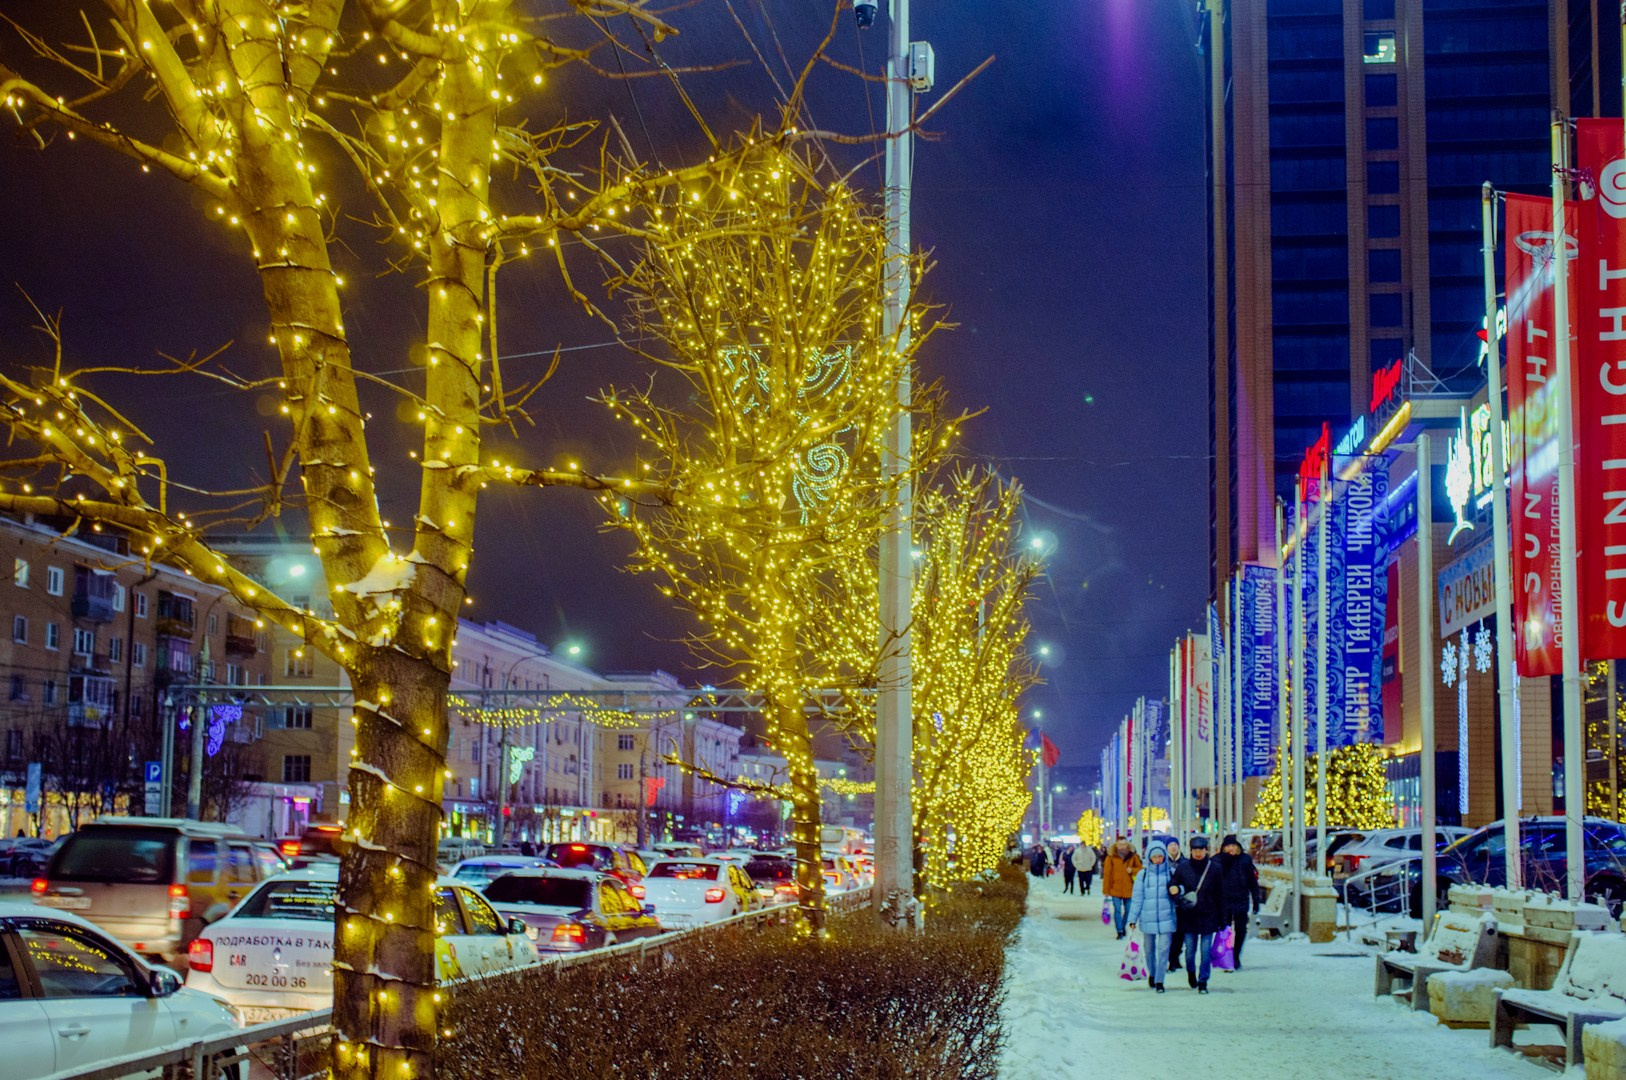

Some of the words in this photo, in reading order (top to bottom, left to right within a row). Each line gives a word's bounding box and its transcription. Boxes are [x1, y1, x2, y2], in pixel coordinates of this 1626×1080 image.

[1347, 471, 1374, 552] ЧИЖОВА
[1346, 564, 1373, 654] ГАЛЕРЕИ
[1254, 645, 1273, 710] ГАЛЕРЕИ
[1345, 665, 1372, 731] ЦЕНТР
[1253, 717, 1271, 766] ЦЕНТР
[215, 936, 292, 948] ПОДРАБОТКА
[295, 938, 304, 948] В
[246, 974, 268, 986] 202
[271, 975, 287, 987] 00
[291, 976, 307, 988] 36
